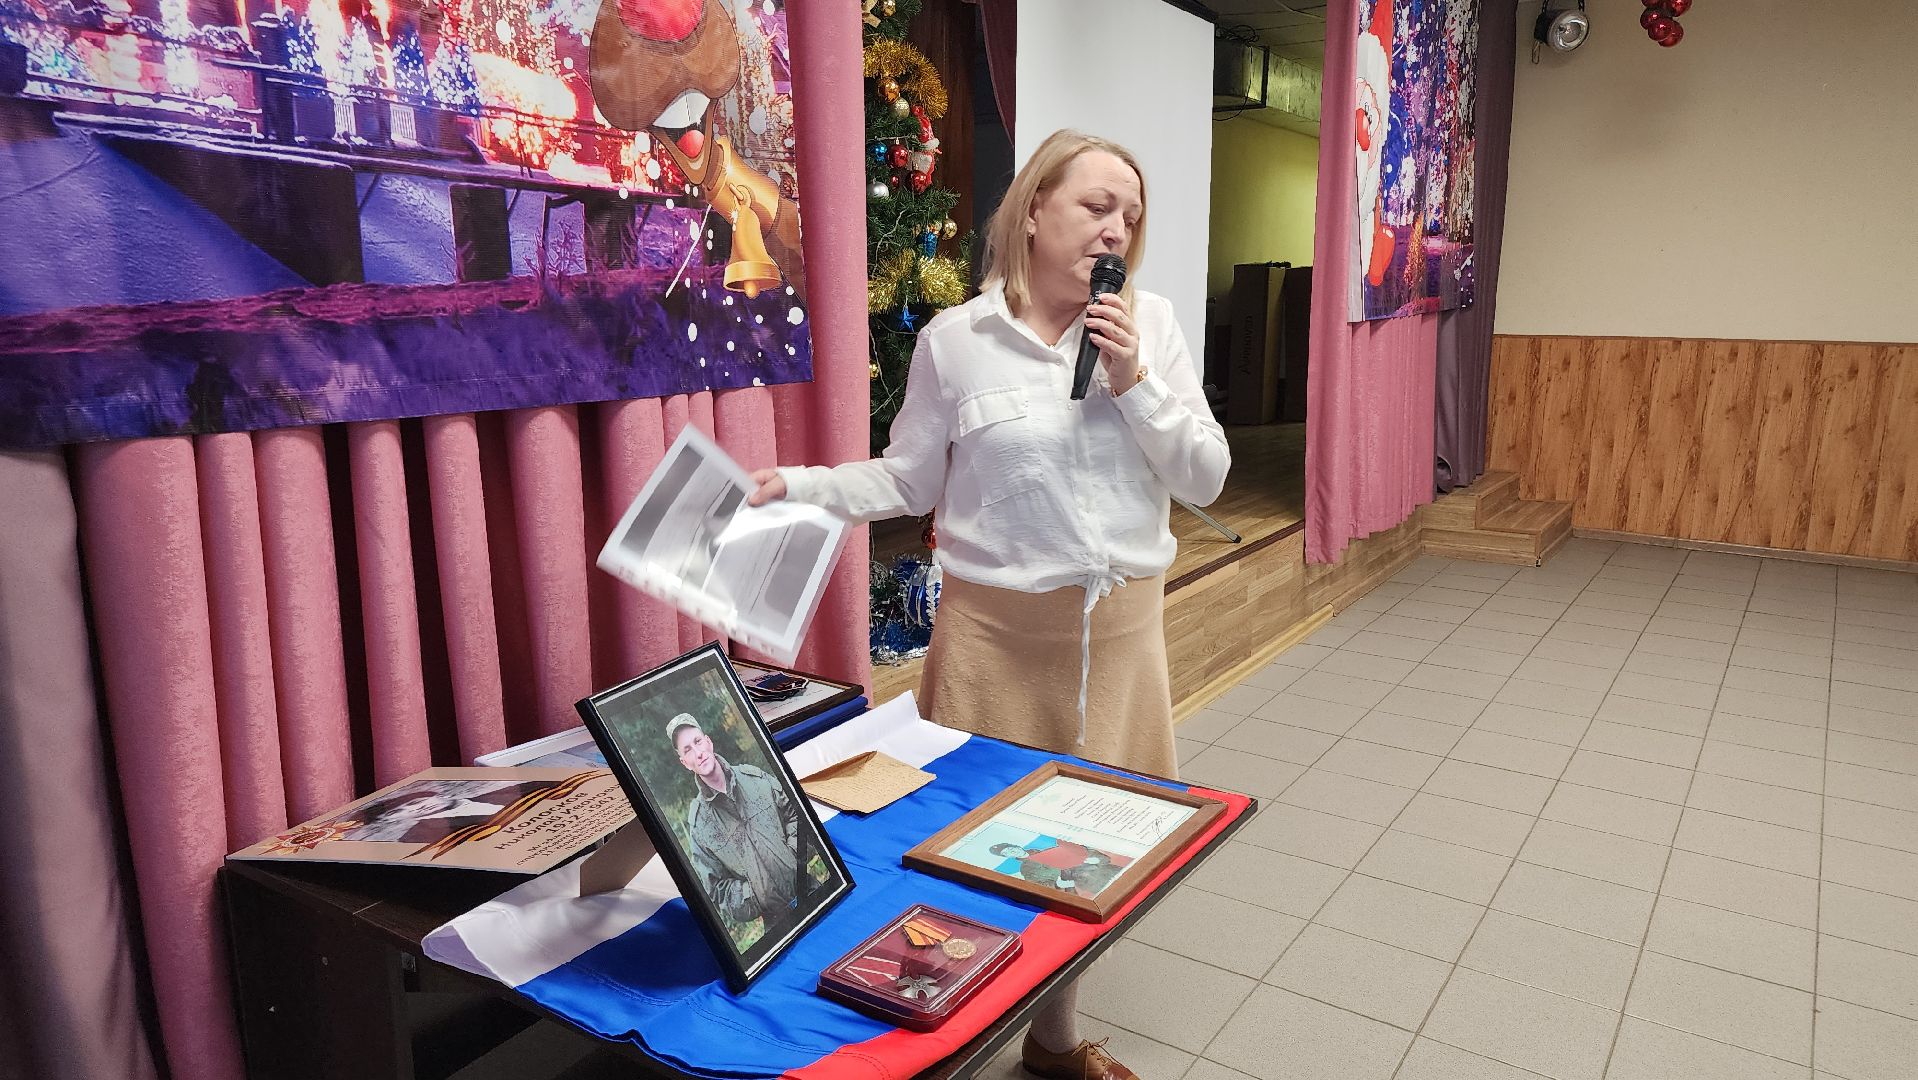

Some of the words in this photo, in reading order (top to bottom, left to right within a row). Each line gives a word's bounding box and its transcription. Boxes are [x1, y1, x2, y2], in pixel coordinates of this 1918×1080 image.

[494, 815, 562, 850] Николай
[560, 784, 621, 816] Иванови
[502, 792, 588, 834] Колосков
